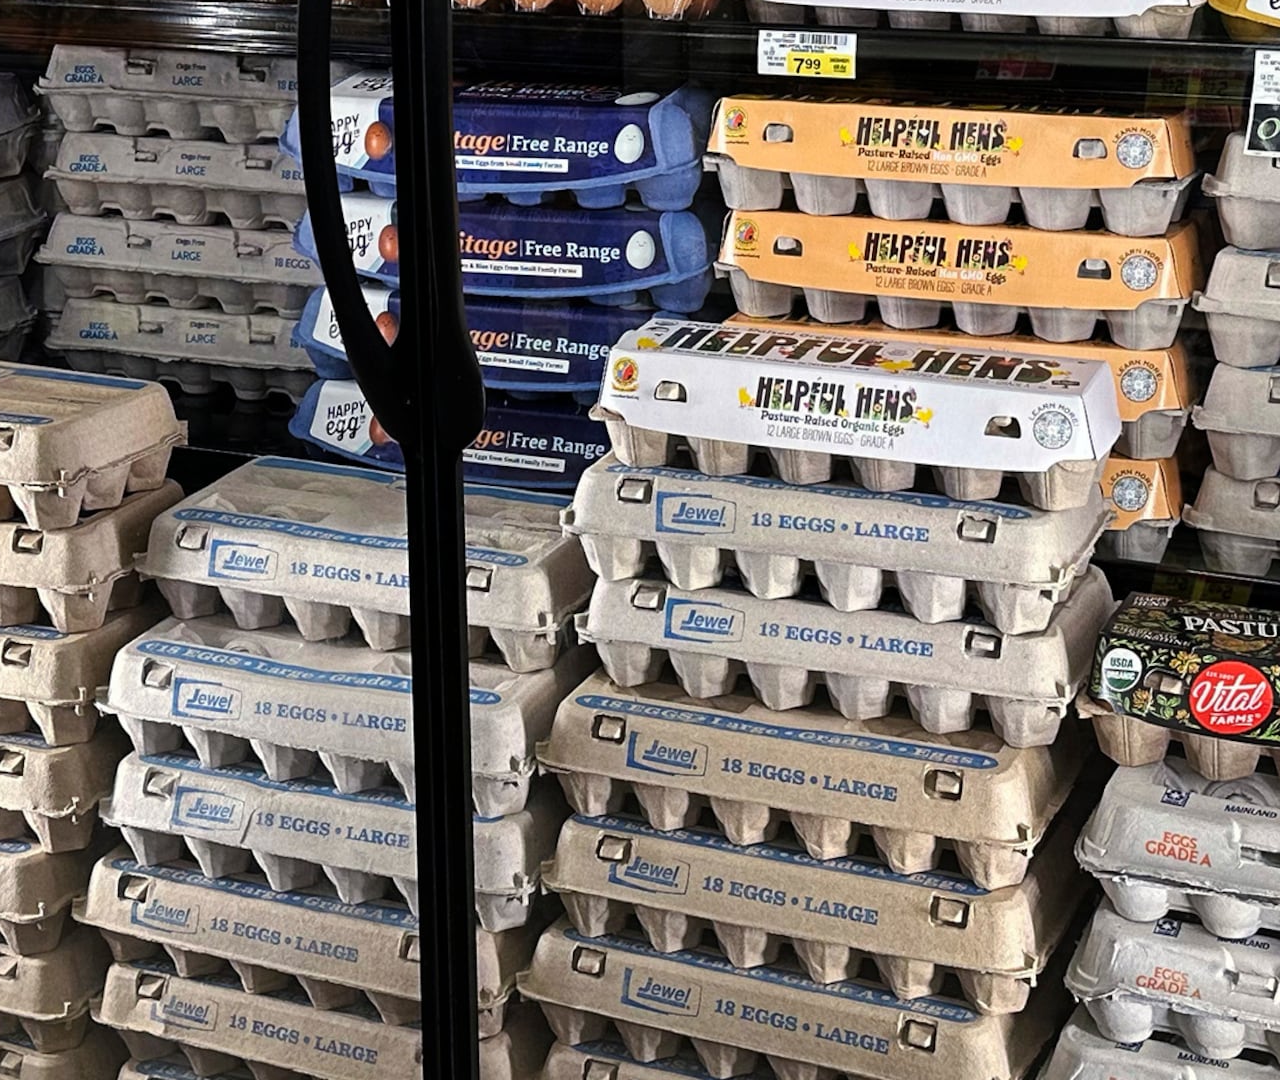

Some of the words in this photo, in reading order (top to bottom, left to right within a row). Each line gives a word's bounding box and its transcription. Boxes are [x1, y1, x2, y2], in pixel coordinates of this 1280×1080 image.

[74, 65, 95, 74] EGGS
[172, 75, 203, 86] LARGE
[512, 135, 549, 152] Free
[554, 137, 608, 157] Range
[858, 147, 930, 161] Pasture-Raised
[933, 150, 952, 160] Non
[954, 152, 978, 162] GMO
[980, 154, 1002, 166] Eggs
[672, 502, 726, 523] Jewel
[752, 512, 772, 528] 18
[778, 514, 837, 534] EGGS
[854, 523, 930, 543] LARGE
[189, 690, 233, 710] Jewel
[1224, 803, 1278, 819] MAINLAND
